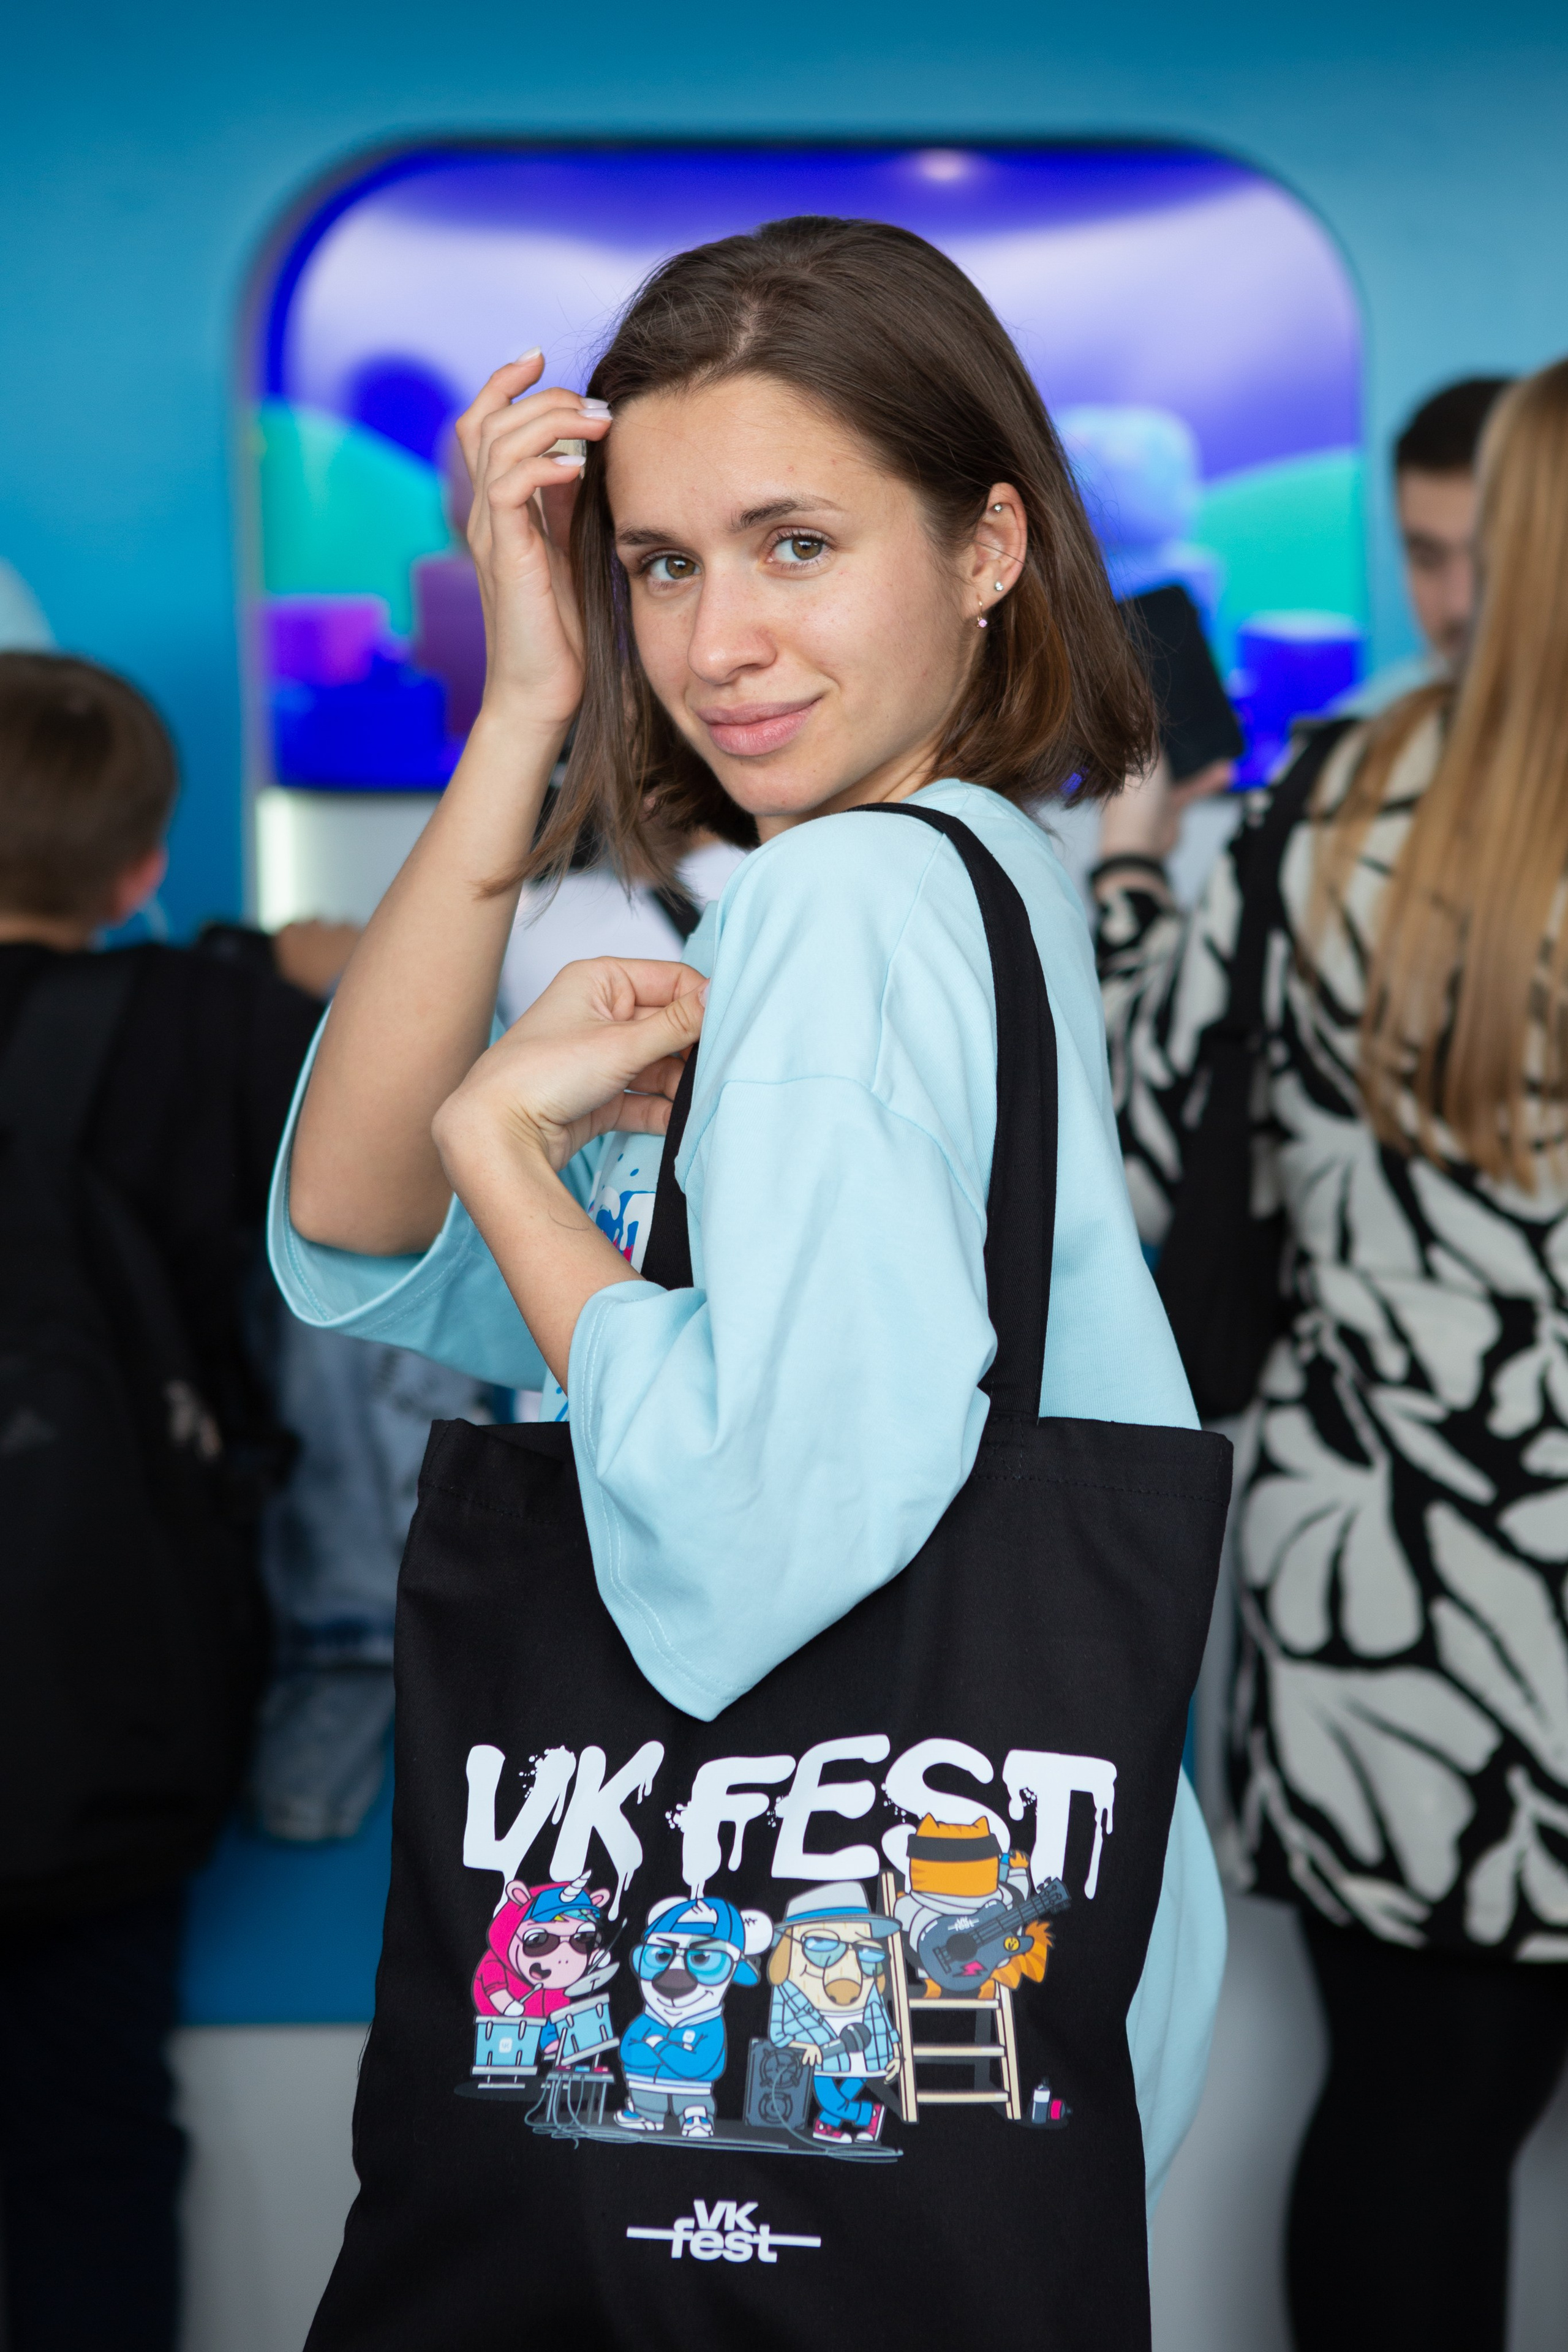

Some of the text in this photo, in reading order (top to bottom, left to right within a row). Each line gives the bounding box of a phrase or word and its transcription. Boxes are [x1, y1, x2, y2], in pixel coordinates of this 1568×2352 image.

[463, 1735, 1117, 1920] VK FEST
[693, 2199, 759, 2232] VK
[671, 2217, 777, 2263] fest
